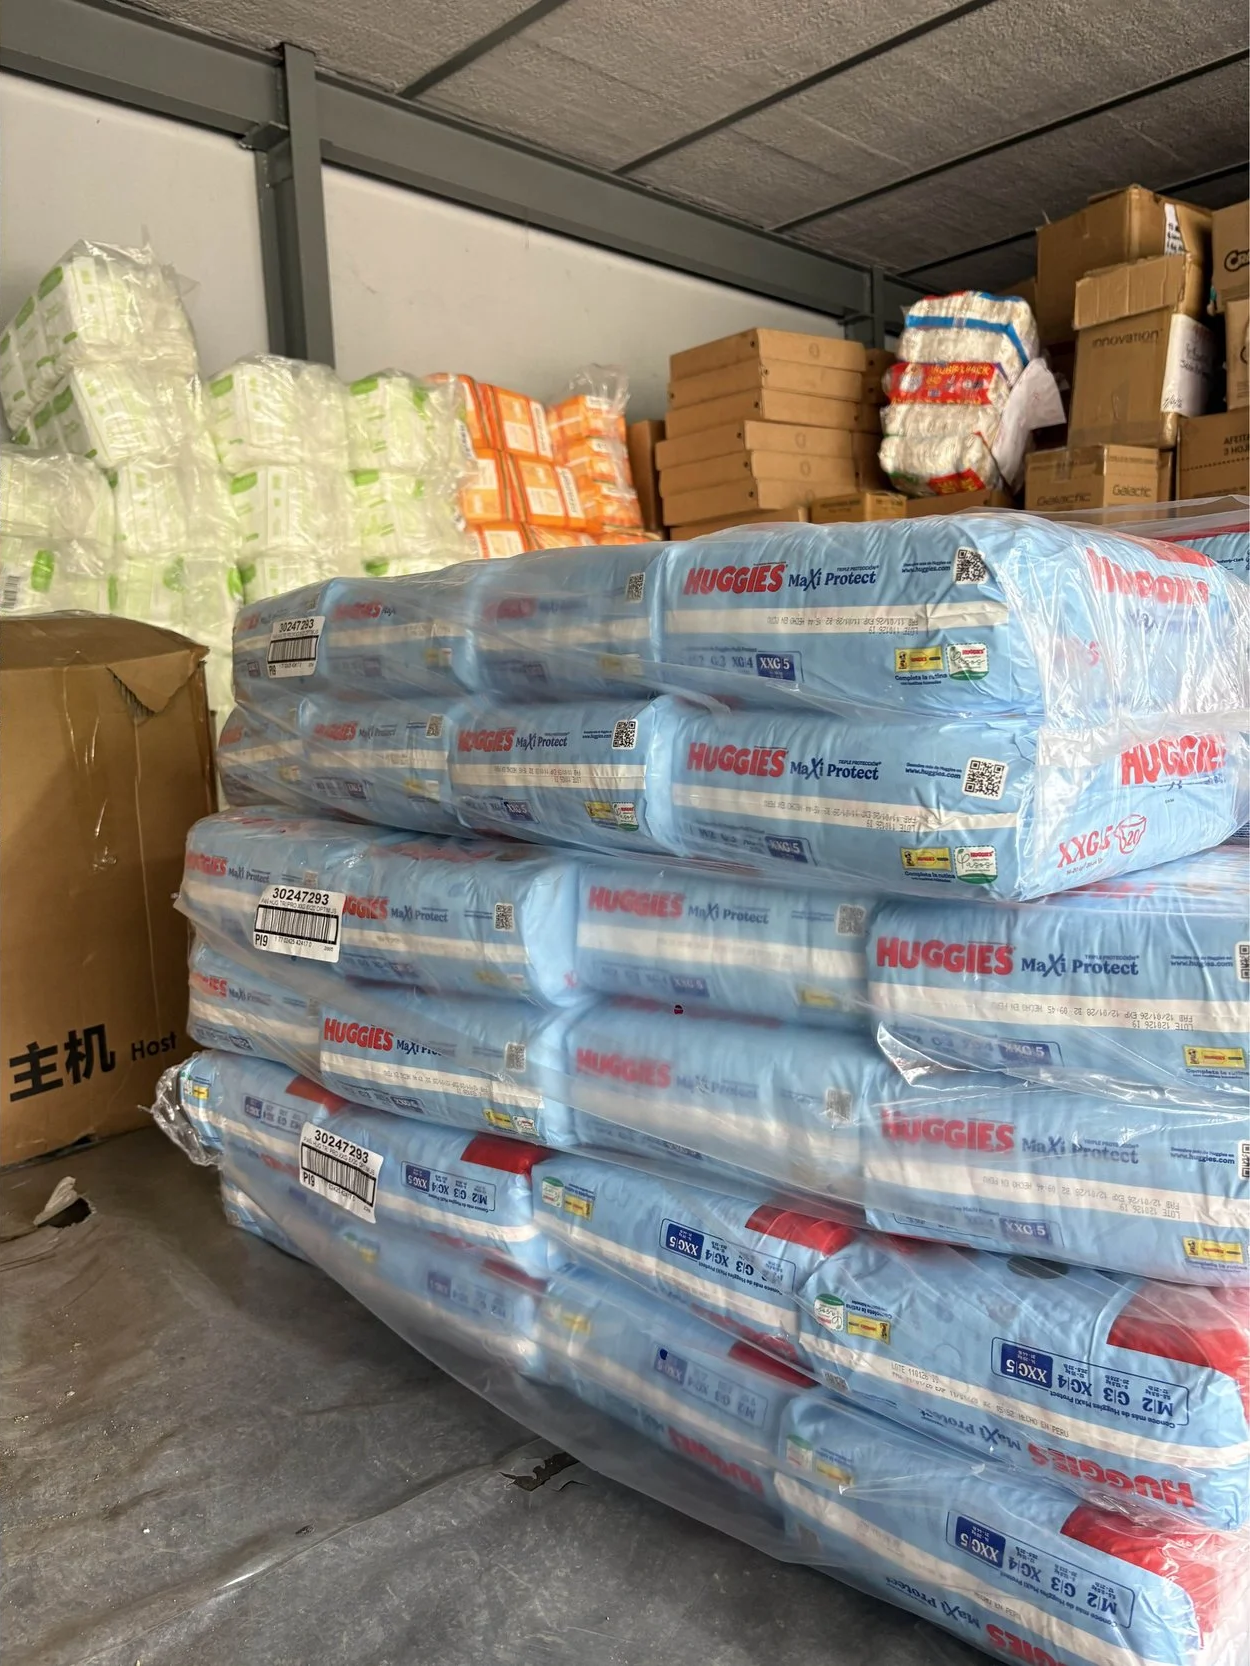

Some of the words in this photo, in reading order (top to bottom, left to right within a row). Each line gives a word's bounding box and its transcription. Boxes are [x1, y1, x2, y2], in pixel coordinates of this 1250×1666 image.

[683, 562, 787, 594] HUGGIES
[824, 571, 877, 587] Protect
[457, 728, 517, 752] HUGGIES
[537, 735, 568, 748] Protect
[687, 742, 787, 777] HUGGIES
[826, 763, 879, 780] Protect
[272, 887, 330, 905] 30247293
[588, 886, 685, 919] HUGGIES
[722, 908, 770, 925] Protect
[415, 910, 448, 923] Protect
[876, 936, 1015, 976] HUGGIES
[1072, 958, 1139, 976] Protect
[130, 1032, 178, 1061] Host
[324, 1017, 393, 1052] HUGGIES
[9, 1024, 117, 1102] 主机
[576, 1047, 671, 1089] HUGGIES
[314, 1128, 370, 1164] 30247293
[881, 1108, 1015, 1153] HUGGIES
[1072, 1142, 1139, 1164] Protect
[1028, 1441, 1196, 1509] HUGGIES
[885, 1576, 937, 1609] Protect
